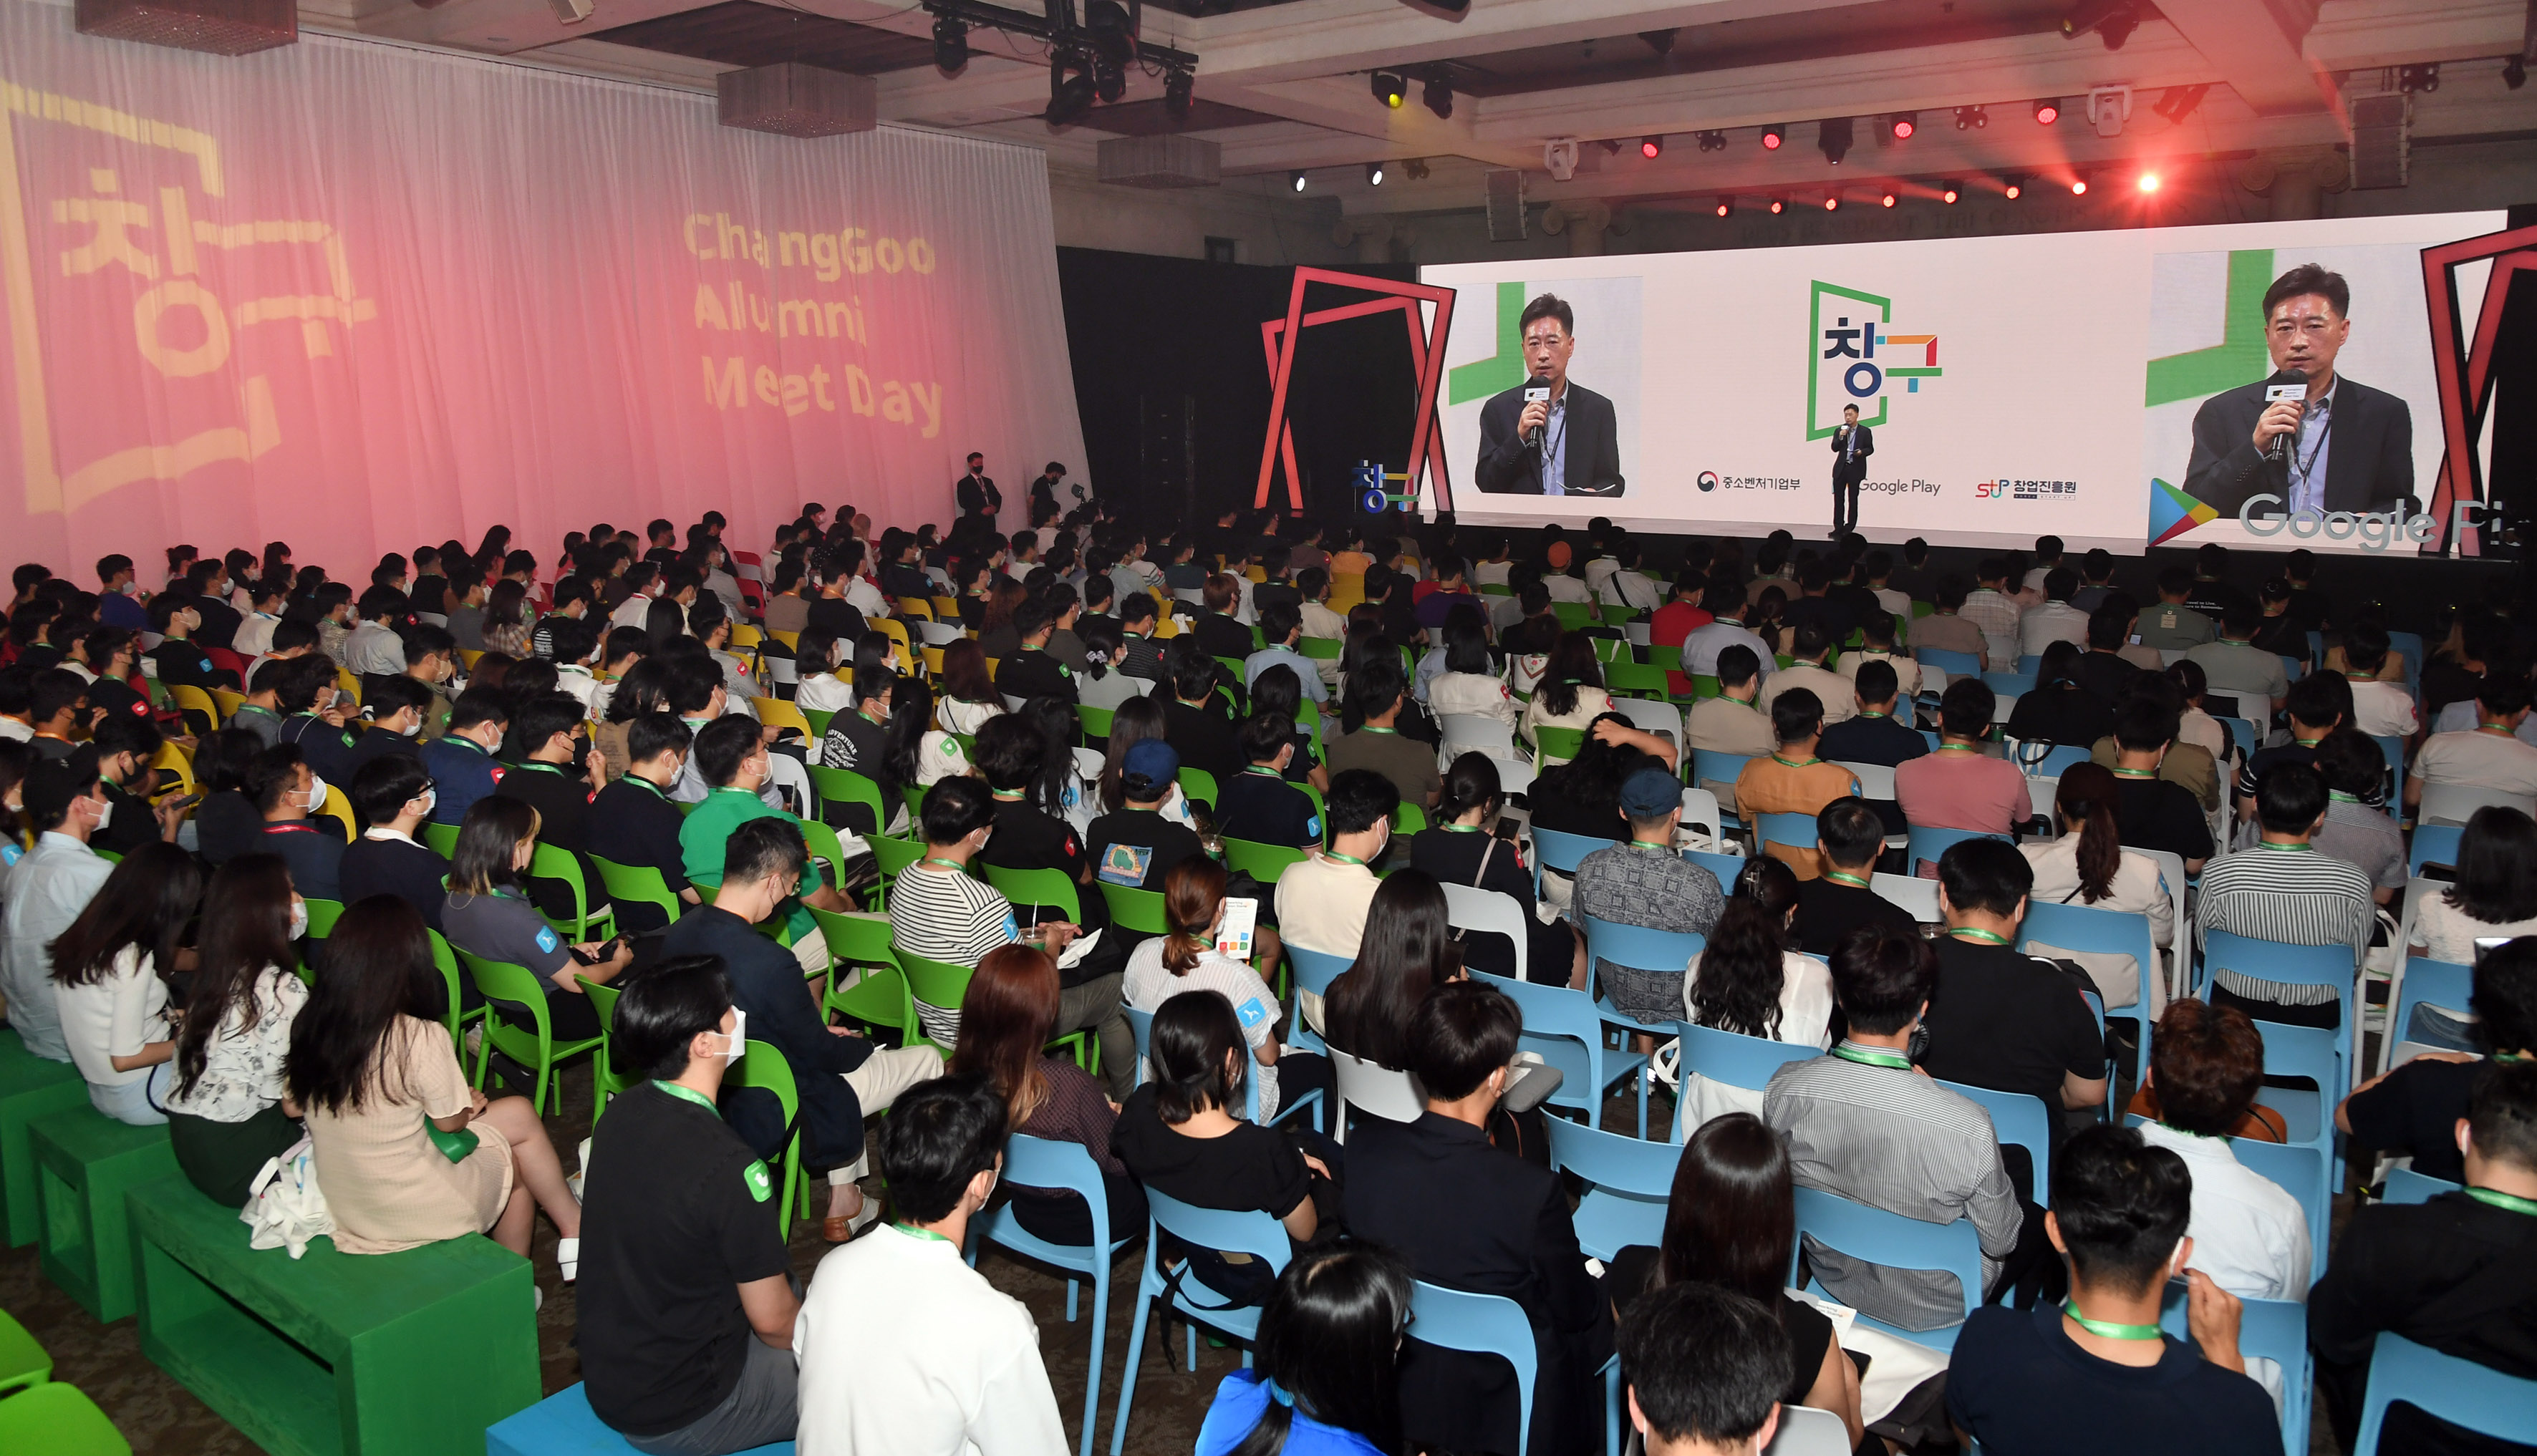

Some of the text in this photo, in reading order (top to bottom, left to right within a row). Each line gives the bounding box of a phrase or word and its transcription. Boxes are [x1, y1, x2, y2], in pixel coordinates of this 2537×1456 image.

[52, 168, 378, 377] 창구
[684, 213, 936, 283] ChangGoo
[694, 281, 867, 348] Alumni
[1824, 316, 1943, 398] 창구
[702, 356, 942, 439] Meet Day
[1722, 476, 1801, 490] 중소벤처기업부
[1911, 479, 1941, 497] Play
[2014, 480, 2077, 494] 창업진흥원
[2238, 492, 2437, 554] Google
